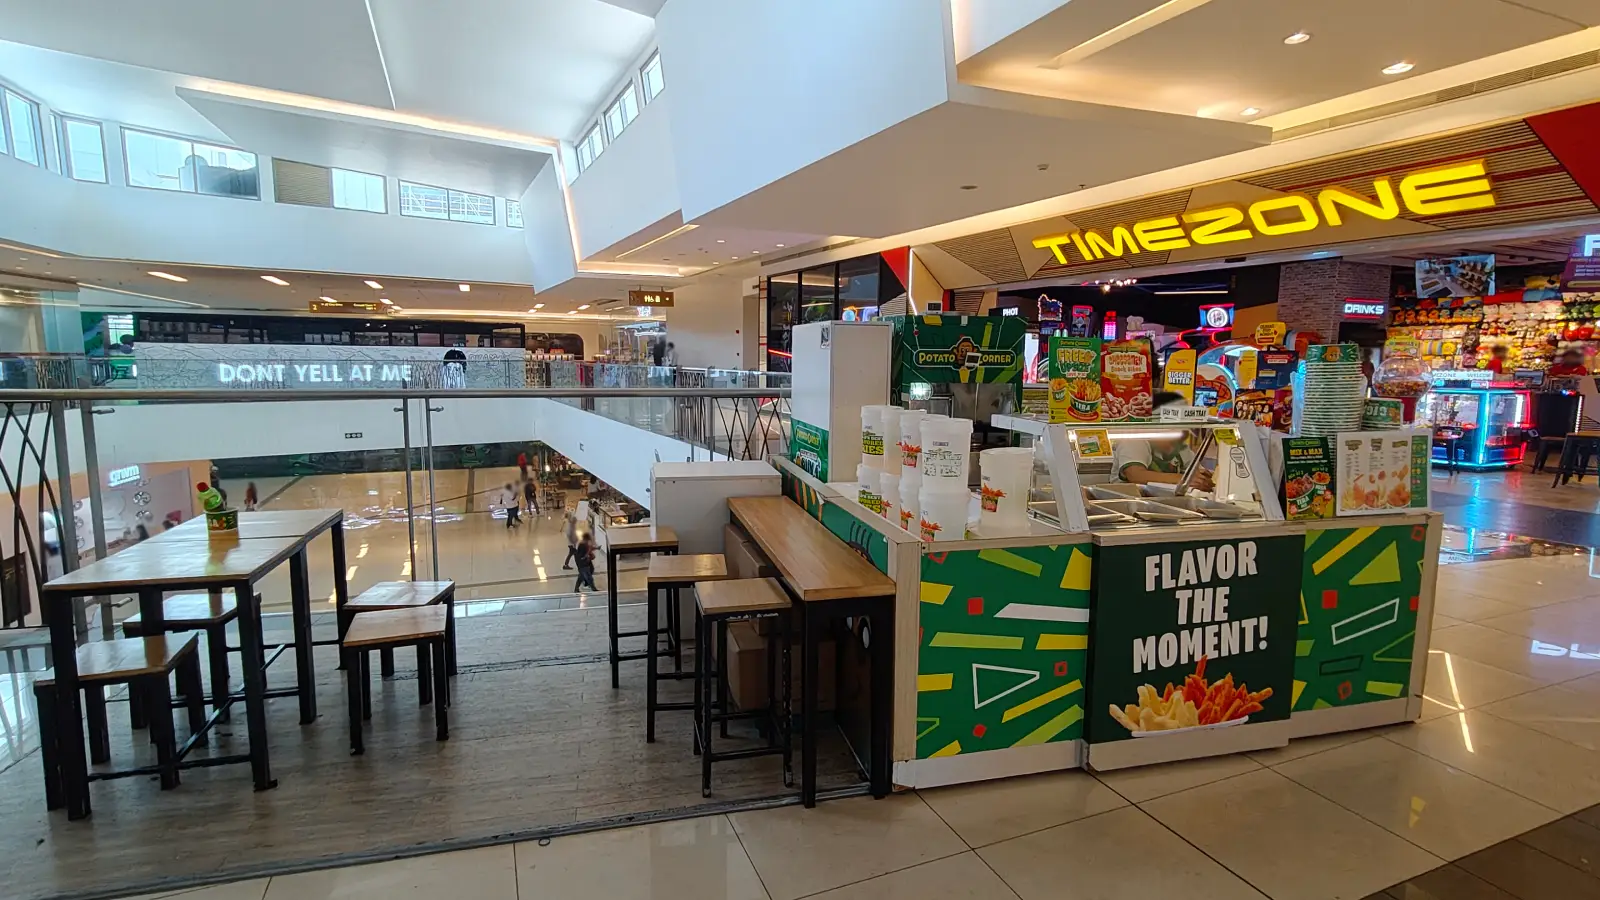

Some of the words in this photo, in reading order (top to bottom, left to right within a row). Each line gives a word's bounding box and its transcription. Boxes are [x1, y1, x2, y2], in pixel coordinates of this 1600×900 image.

[1032, 158, 1496, 265] TIMEZONE
[1344, 303, 1384, 315] DRINKS
[918, 352, 956, 364] POTATO
[1057, 349, 1091, 363] FREE
[218, 363, 285, 383] DONT
[295, 363, 343, 383] YELL
[350, 362, 374, 383] AT
[380, 363, 412, 383] ME
[1167, 371, 1192, 379] BIGGER
[1168, 377, 1191, 385] BETTER
[1145, 541, 1258, 592] FLAVOR
[1175, 586, 1230, 625] THE
[1133, 616, 1268, 674] MOMENT!
